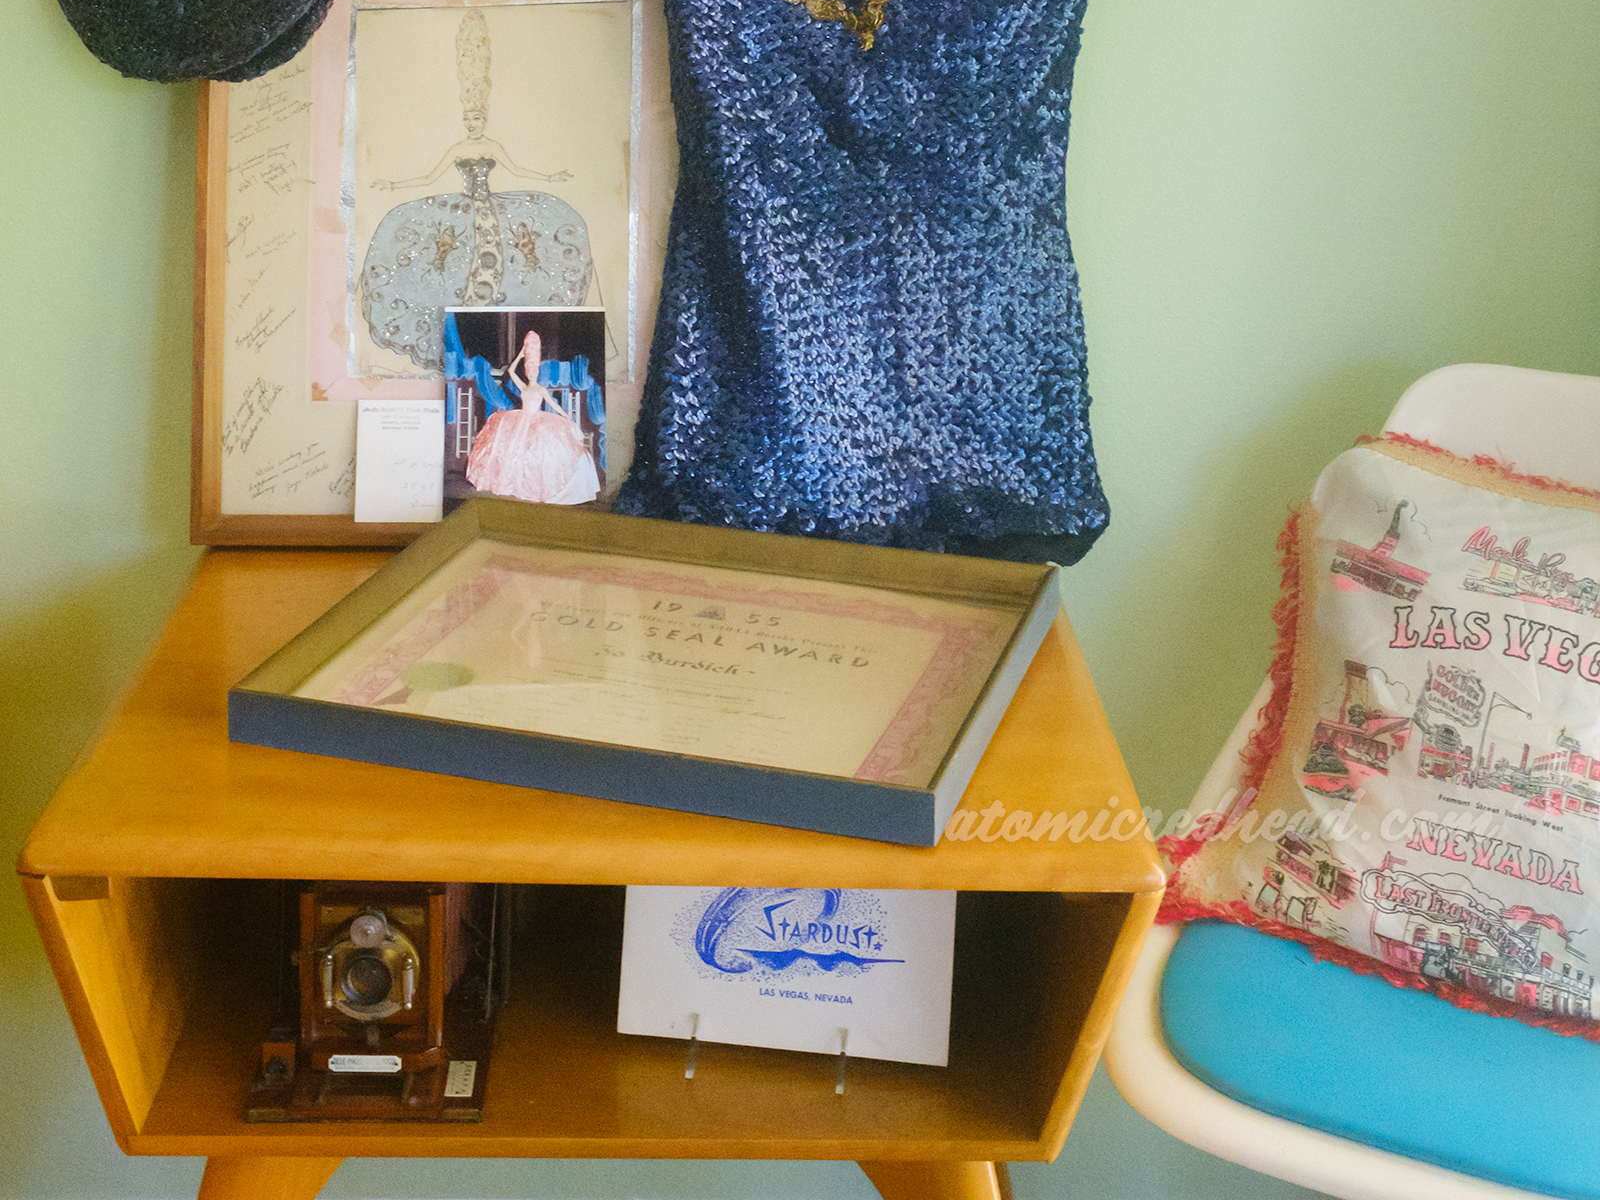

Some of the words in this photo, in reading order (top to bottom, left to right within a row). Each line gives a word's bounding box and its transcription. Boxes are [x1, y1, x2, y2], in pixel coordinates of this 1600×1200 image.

[652, 600, 683, 613] 19
[745, 613, 781, 627] 55
[1389, 605, 1492, 651] LAS
[529, 611, 624, 632] GOLD
[645, 626, 724, 647] SEAL
[745, 641, 869, 668] AWARD
[1438, 794, 1471, 807] Fremont
[1475, 802, 1500, 814] Street
[1505, 809, 1537, 826] looking
[1542, 820, 1564, 832] West
[1405, 817, 1584, 895] NEVADA
[1374, 876, 1428, 908] LAST
[759, 987, 776, 997] LAS
[779, 989, 811, 1002] VEGAS,
[814, 993, 853, 1005] NEVADA
